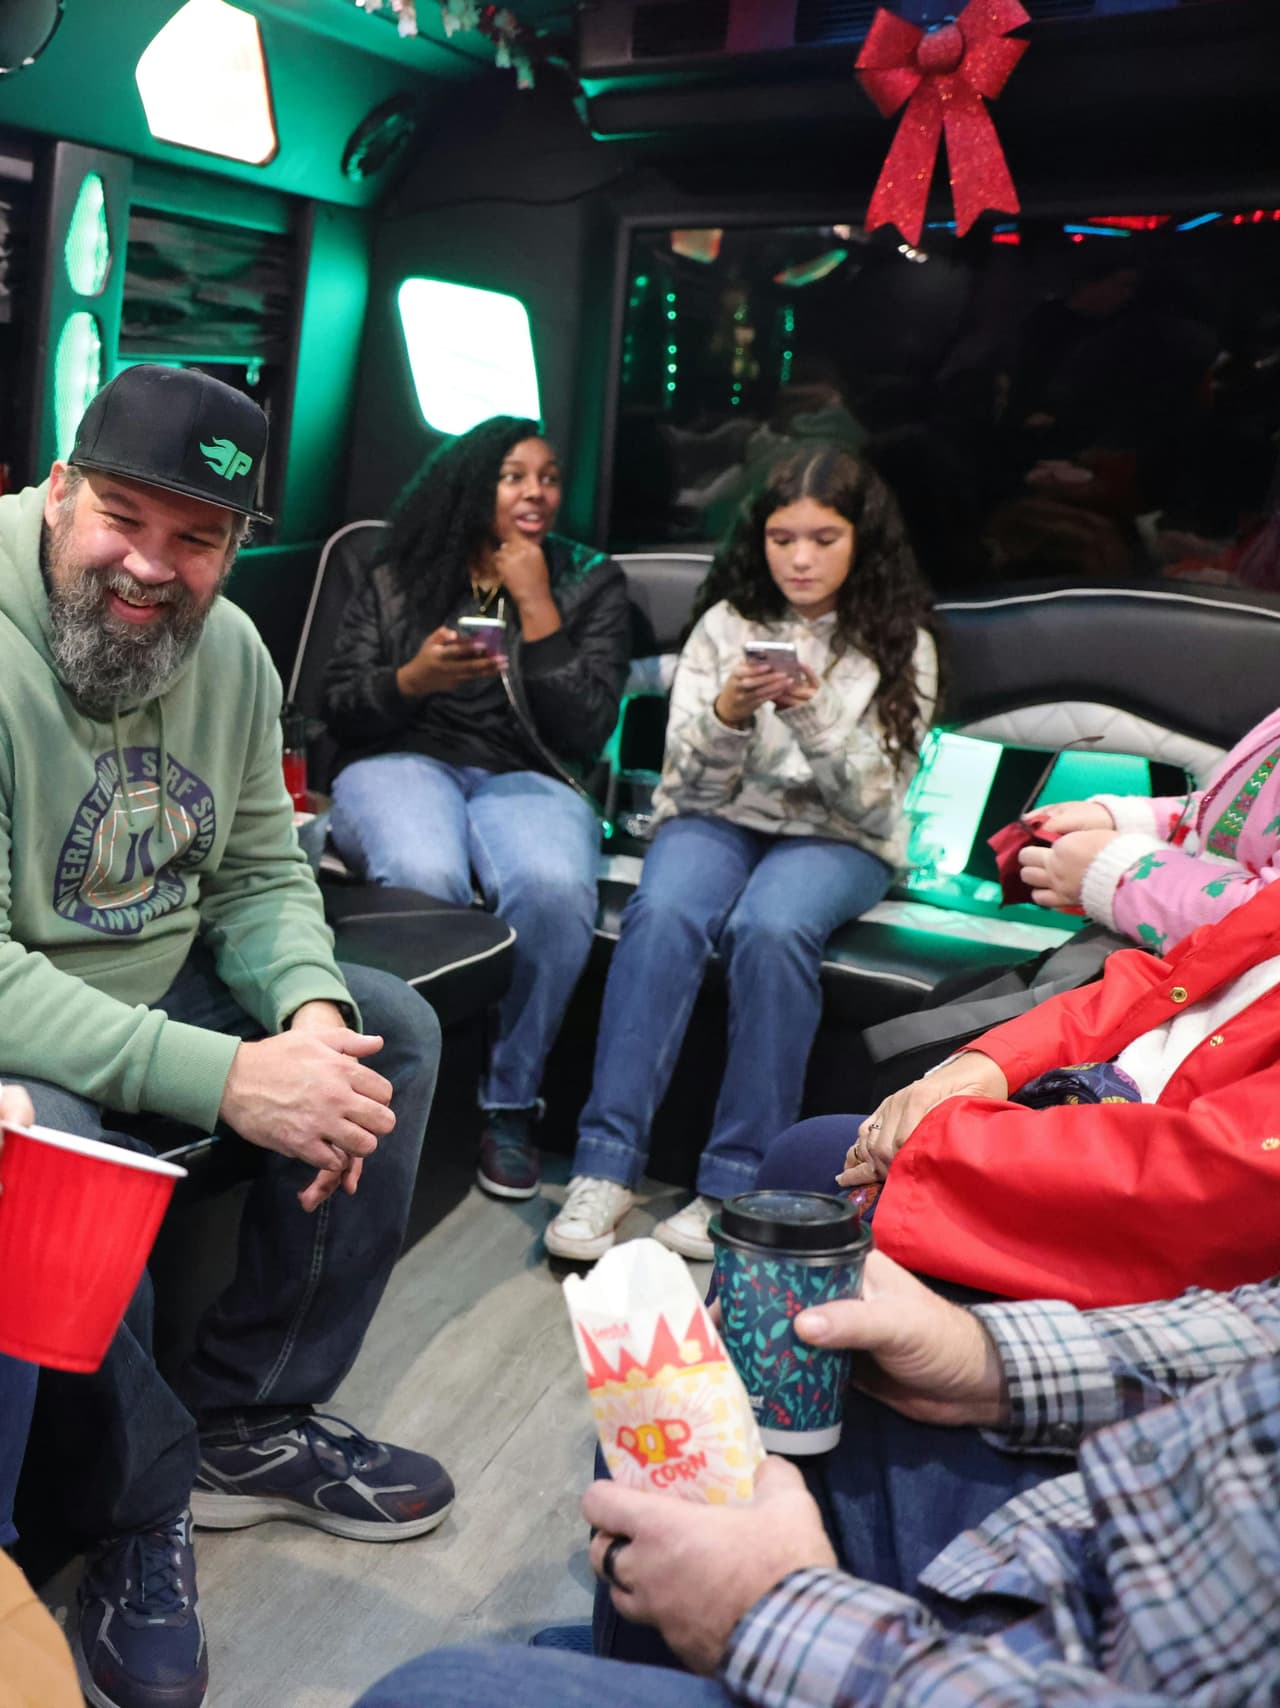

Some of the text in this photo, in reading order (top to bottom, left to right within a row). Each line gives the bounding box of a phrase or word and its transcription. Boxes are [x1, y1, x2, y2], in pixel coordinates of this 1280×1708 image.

[140, 751, 198, 799] SRF
[616, 1418, 692, 1469] POP
[650, 1450, 708, 1489] CORN
